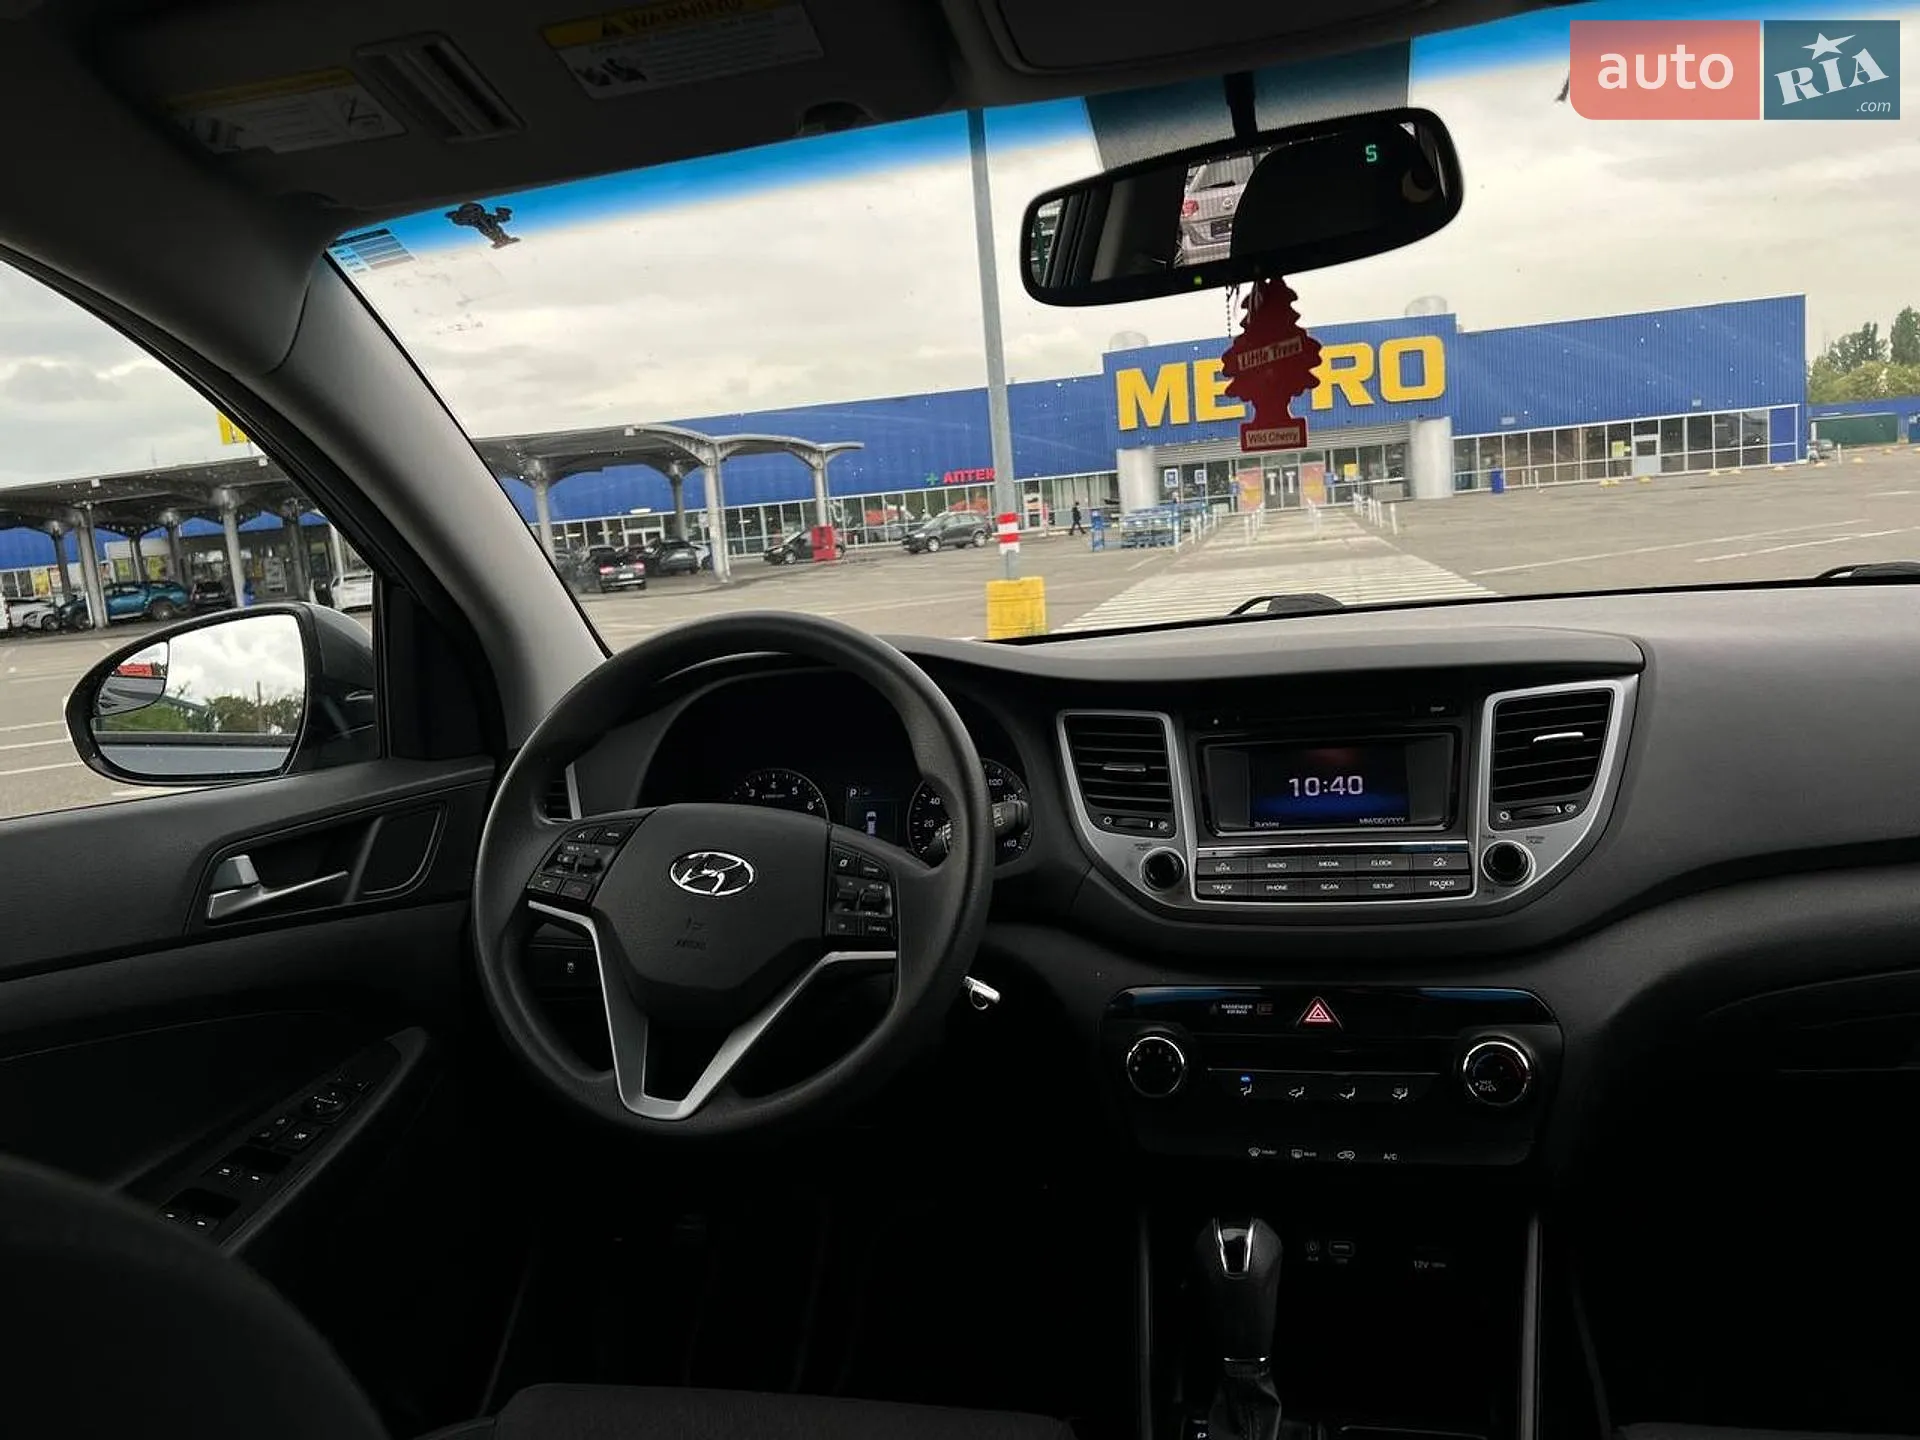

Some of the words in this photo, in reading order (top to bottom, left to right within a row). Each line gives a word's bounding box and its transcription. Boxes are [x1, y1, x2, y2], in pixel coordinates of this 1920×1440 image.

[1365, 144, 1377, 162] S
[1240, 348, 1270, 369] Little
[1116, 335, 1446, 431] MERO
[1247, 430, 1267, 444] Wild
[1268, 428, 1299, 442] Cherry
[1289, 775, 1363, 799] 10:40
[930, 796, 941, 806] 40
[924, 819, 935, 829] 20
